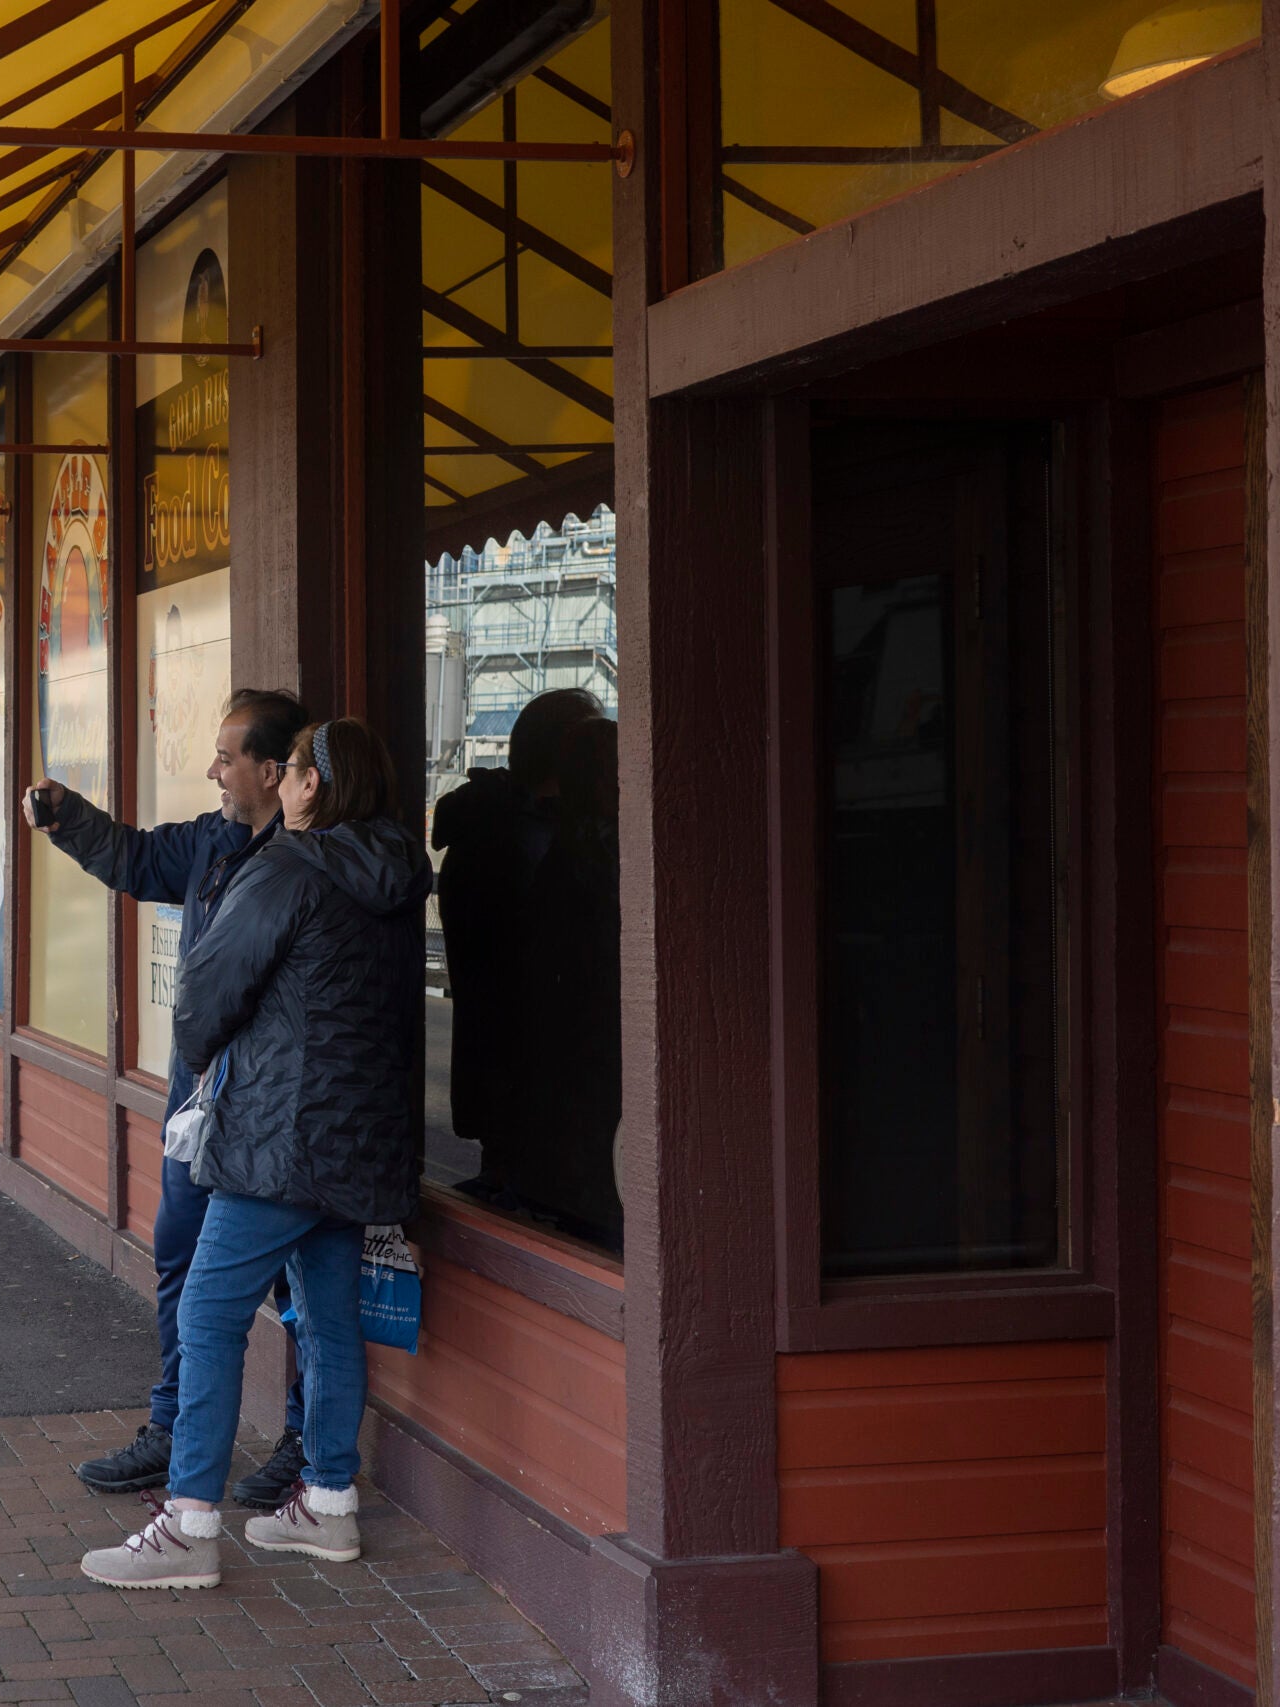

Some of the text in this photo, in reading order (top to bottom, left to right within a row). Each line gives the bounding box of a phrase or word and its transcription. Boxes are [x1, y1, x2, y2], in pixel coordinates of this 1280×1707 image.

[168, 385, 200, 453] GOLD
[143, 442, 230, 573] Food Co
